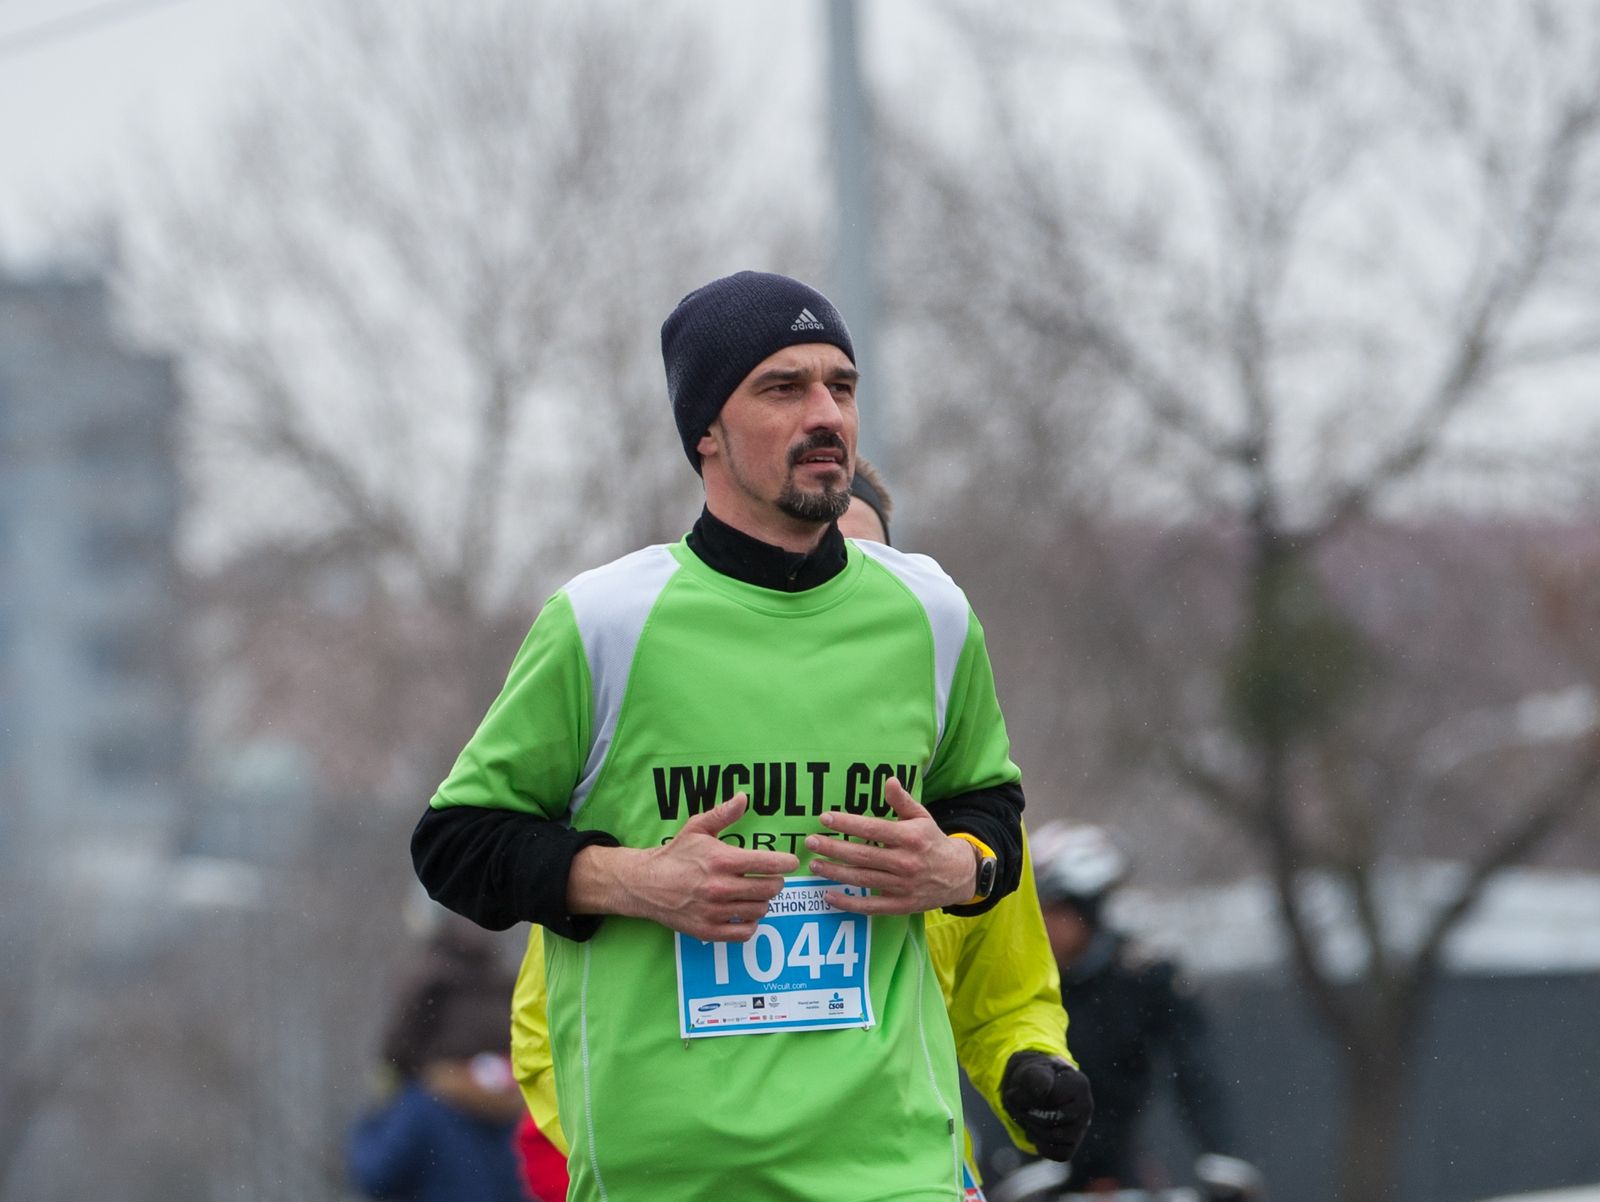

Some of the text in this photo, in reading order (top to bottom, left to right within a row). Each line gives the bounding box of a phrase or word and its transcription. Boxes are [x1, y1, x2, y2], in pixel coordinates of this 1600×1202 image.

[791, 322, 824, 331] adidas
[770, 890, 829, 901] RATISLAV
[768, 900, 831, 913] ATHON 2013
[702, 920, 859, 984] 1044
